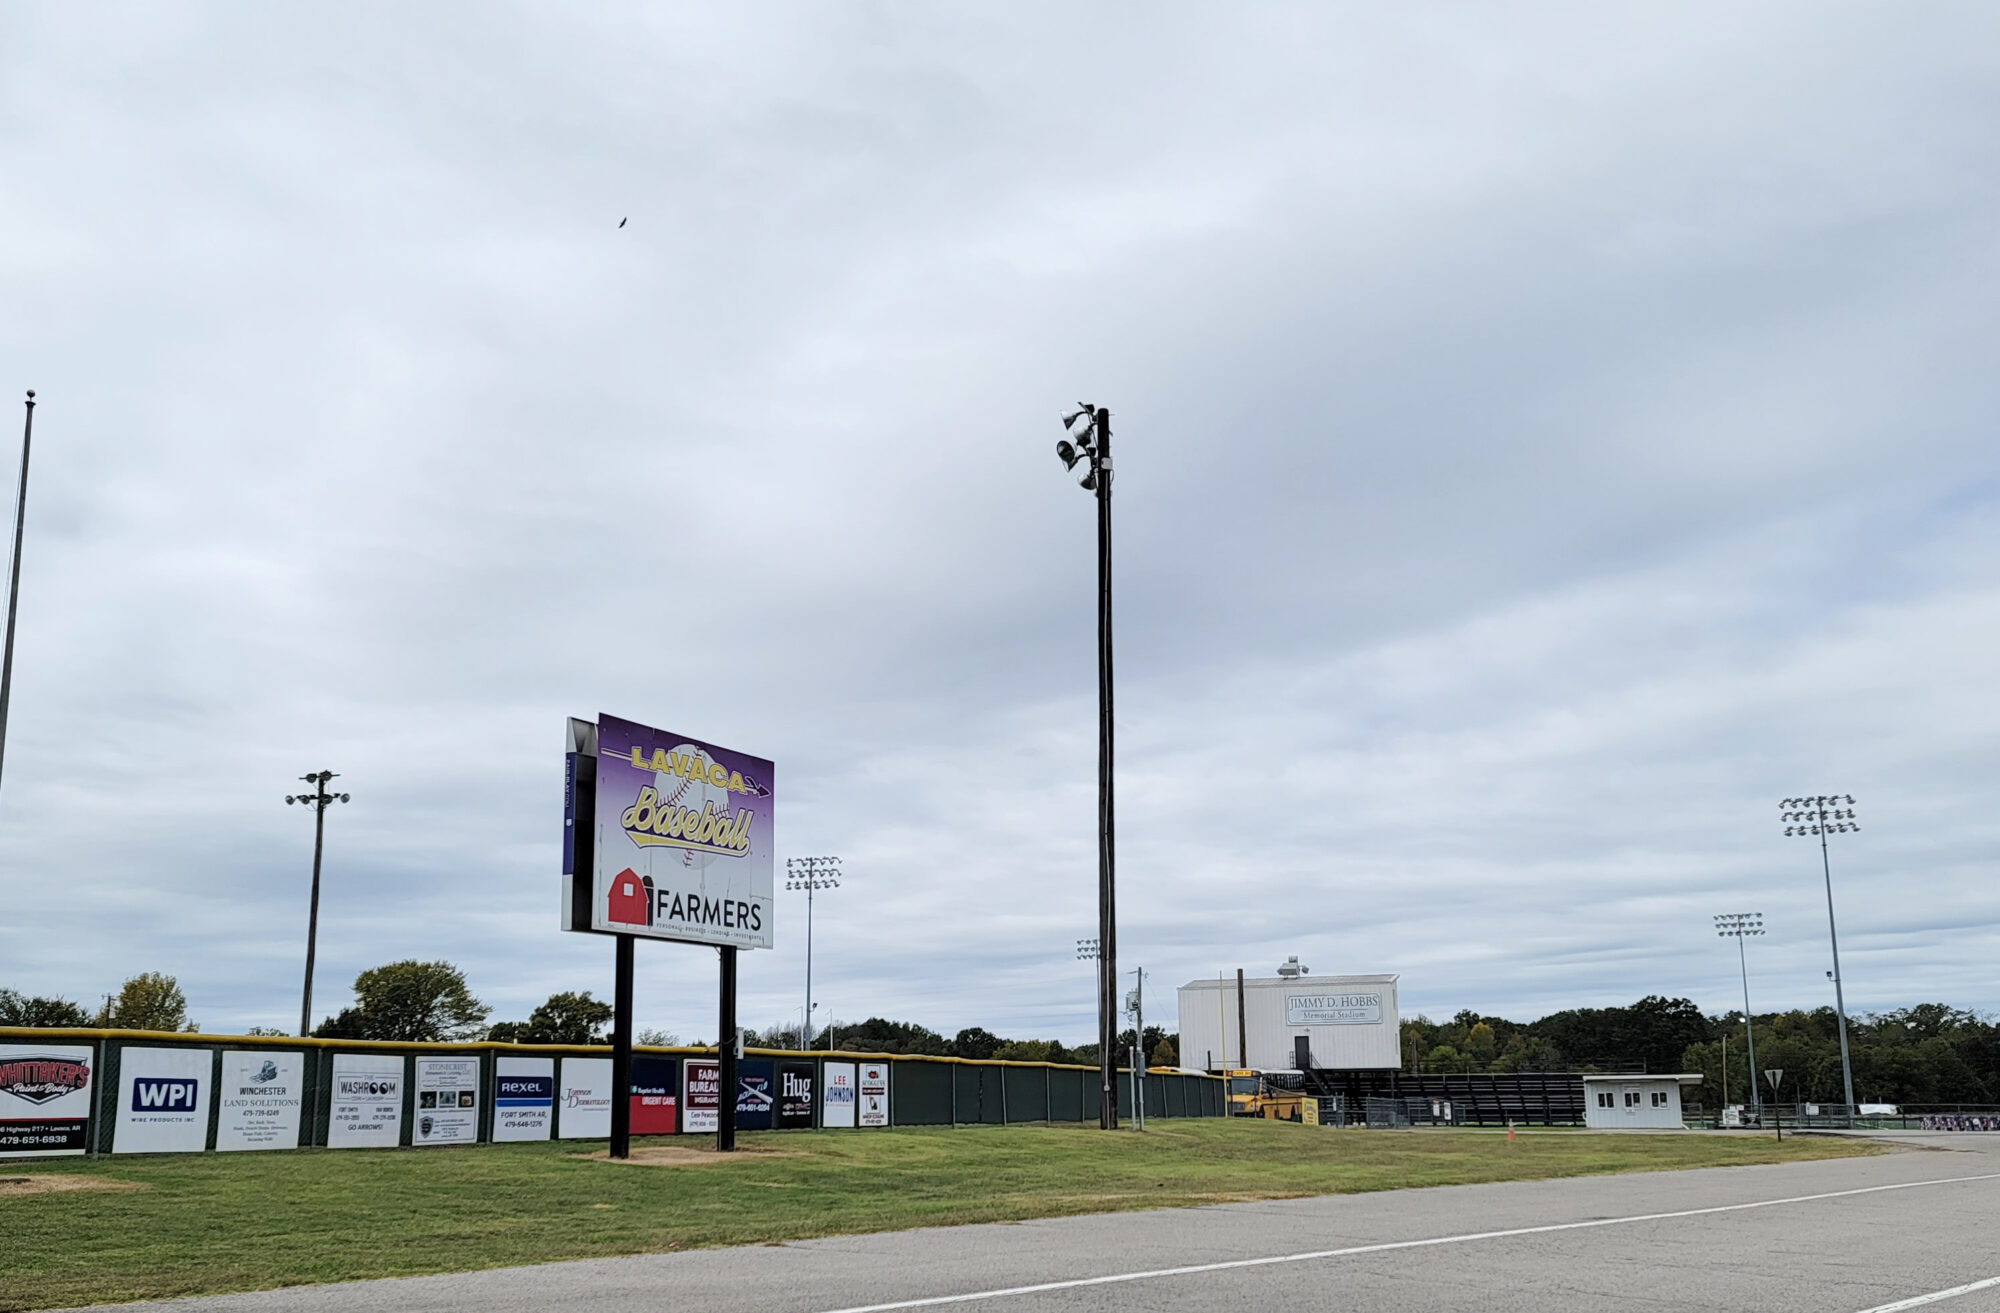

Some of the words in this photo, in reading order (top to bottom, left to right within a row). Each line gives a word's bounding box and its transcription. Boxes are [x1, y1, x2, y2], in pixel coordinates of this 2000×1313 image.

[632, 746, 747, 794] LAVACA
[621, 785, 754, 850] Baseball
[657, 889, 762, 931] FARMERS
[1290, 998, 1325, 1011] JIMMY
[1327, 998, 1338, 1007] D.
[1341, 996, 1378, 1007] HOBBS
[1303, 1011, 1335, 1019] Memorial
[1338, 1011, 1366, 1019] Stadium
[698, 1069, 719, 1080] FARM
[834, 1075, 846, 1085] LEE
[13, 1083, 38, 1094] Paint
[44, 1083, 69, 1097] Body
[239, 1087, 287, 1096] WINCHESTER
[341, 1082, 396, 1095] WASHROOM
[782, 1073, 812, 1103] Hug
[826, 1086, 854, 1103] JOHNSON
[138, 1083, 194, 1107] WPI
[641, 1096, 662, 1106] URGENT
[662, 1096, 676, 1106] CARE
[249, 1099, 299, 1107] SOLUTIONS
[501, 1111, 517, 1119] FORT
[518, 1110, 536, 1118] SMITH
[1, 1135, 68, 1144] 479-651-6938
